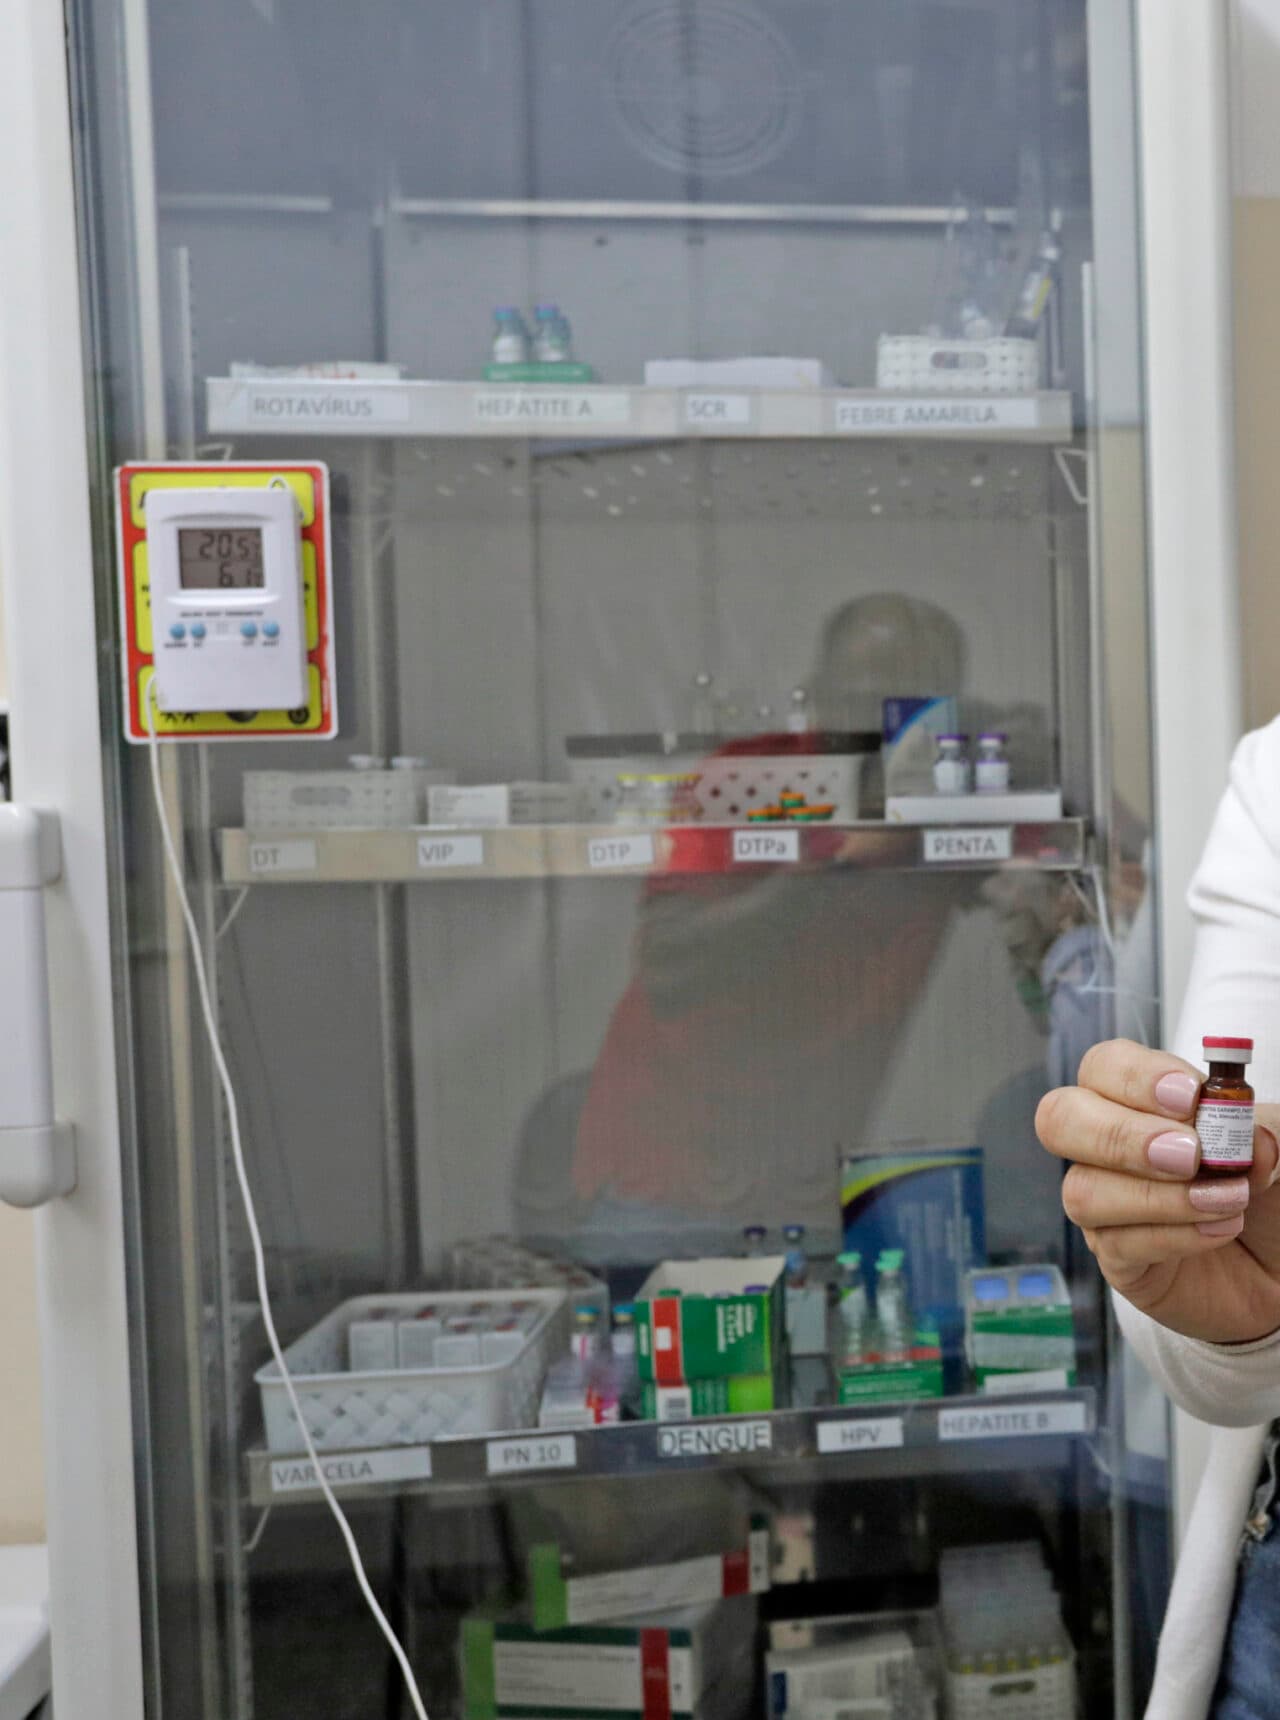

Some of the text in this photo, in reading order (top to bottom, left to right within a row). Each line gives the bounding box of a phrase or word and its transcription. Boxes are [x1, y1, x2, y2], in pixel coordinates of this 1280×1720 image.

[253, 392, 373, 418] ROTAVÍRUS
[477, 398, 592, 418] HEPATITE A
[689, 401, 728, 419] SCR
[838, 404, 998, 426] FEBRE AMARELA
[419, 844, 454, 863] VIP
[591, 843, 631, 863] DTP
[737, 838, 787, 857] DTPa
[933, 837, 998, 856] PENTA
[253, 848, 281, 867] DT
[942, 1412, 1049, 1433] HEPATITE B
[659, 1424, 769, 1456] DENGUE
[841, 1426, 882, 1444] HPV
[503, 1443, 562, 1464] PN 10
[275, 1460, 374, 1486] VARCELA
